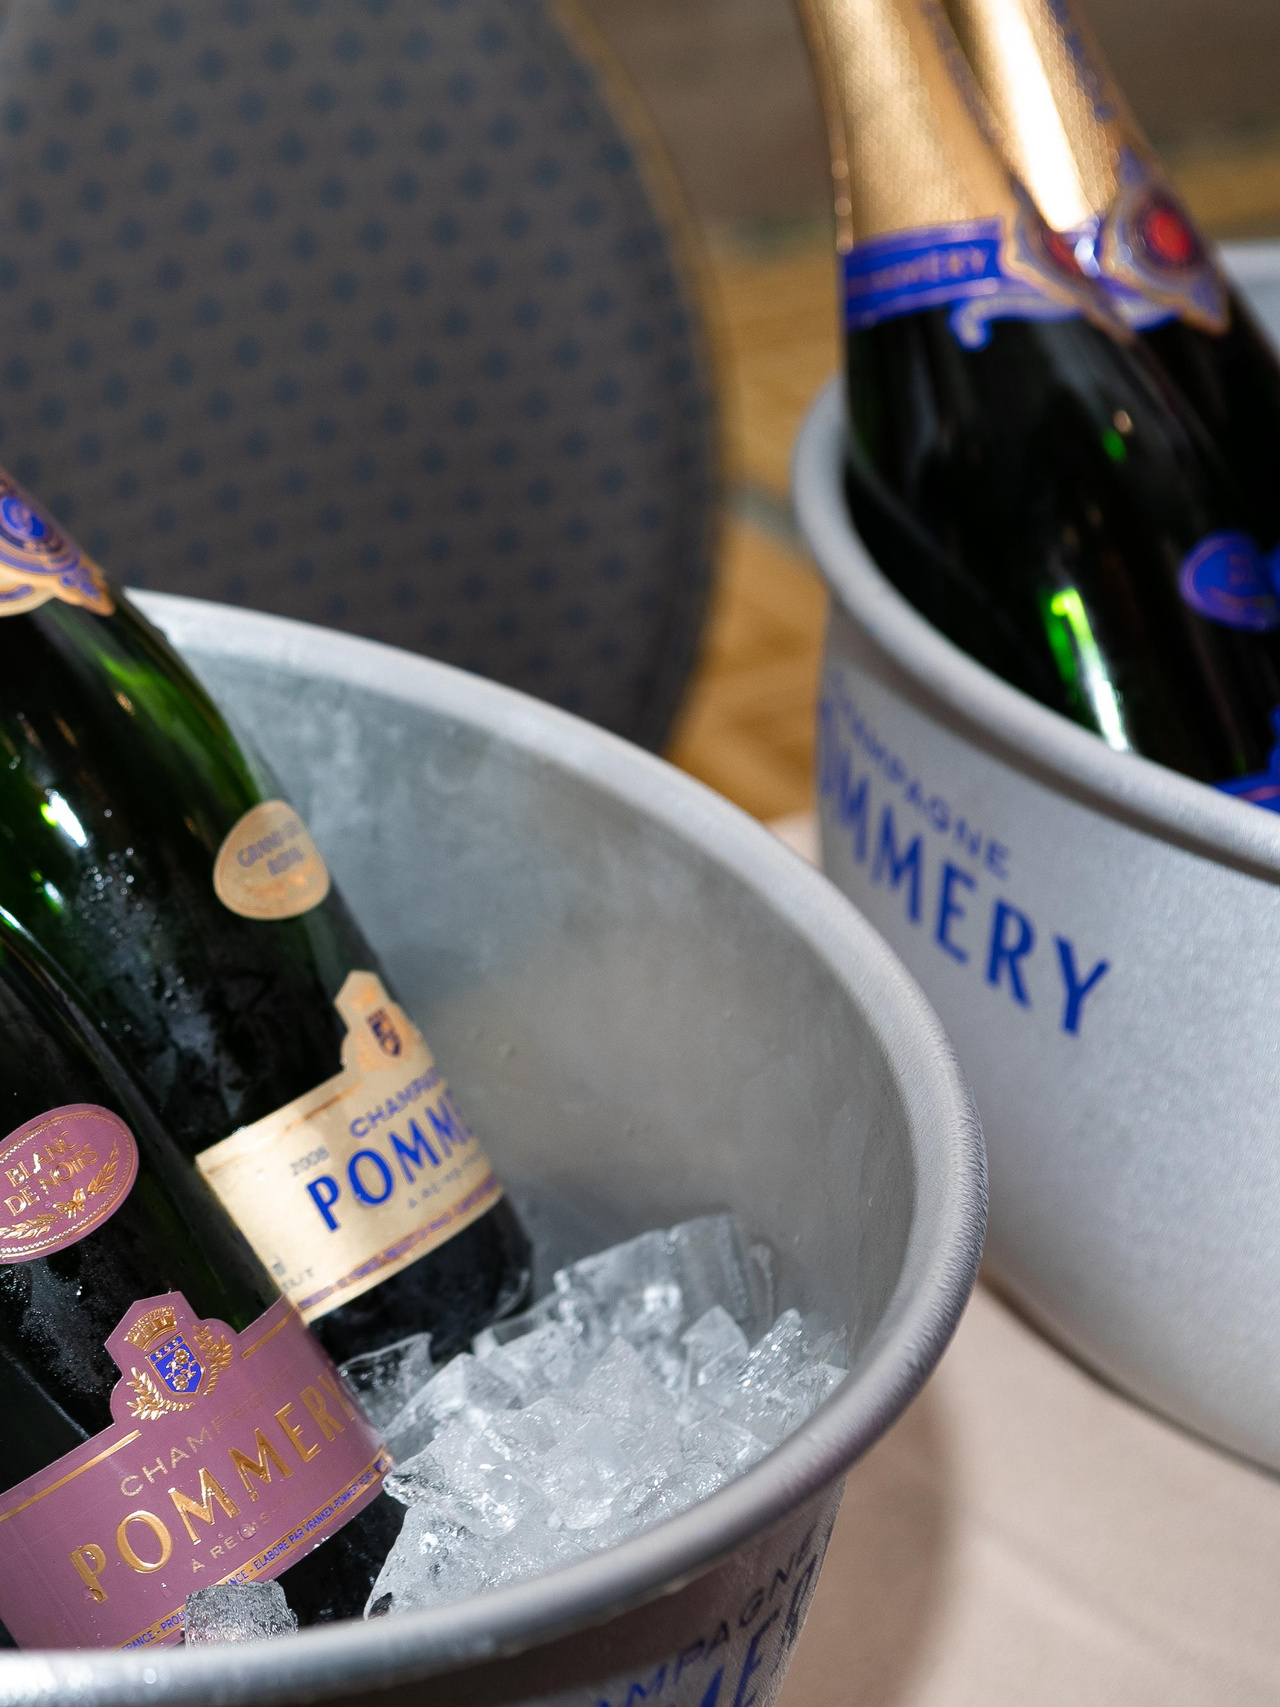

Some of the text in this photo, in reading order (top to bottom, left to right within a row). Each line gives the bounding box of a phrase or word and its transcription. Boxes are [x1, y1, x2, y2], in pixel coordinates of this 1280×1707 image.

[4, 1143, 98, 1217] DE NOIRS
[5, 1130, 76, 1188] BLANC
[288, 1527, 305, 1545] PAR
